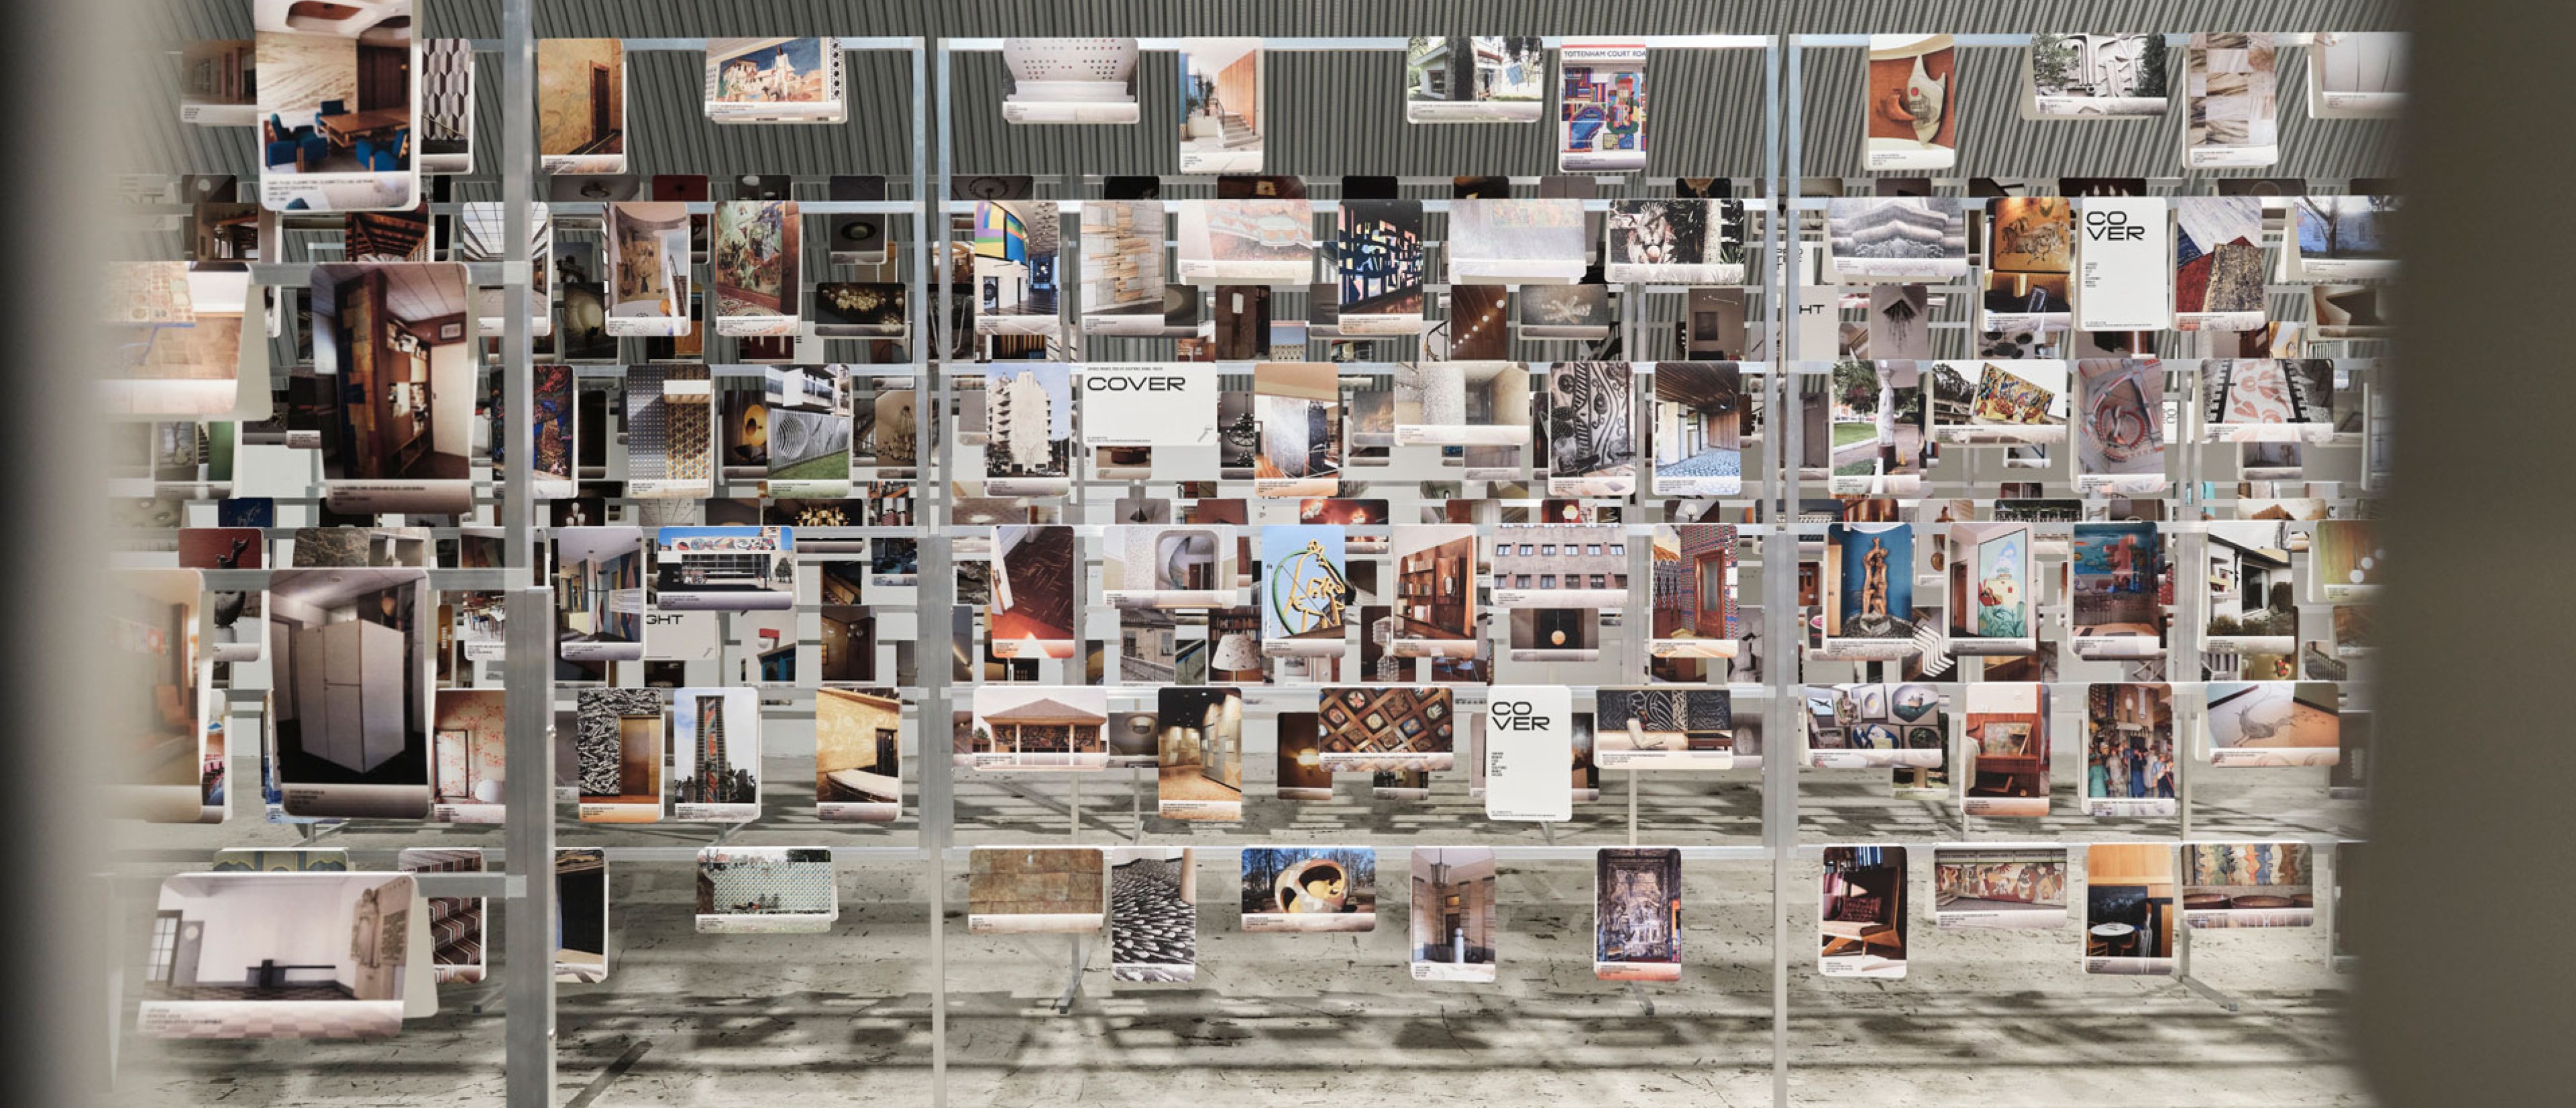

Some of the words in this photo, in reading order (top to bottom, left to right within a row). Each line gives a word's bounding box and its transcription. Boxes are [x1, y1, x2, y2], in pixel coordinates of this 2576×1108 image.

[2086, 211, 2127, 225] CO
[2086, 226, 2145, 241] VER
[1087, 376, 1185, 391] COVER
[1491, 701, 1532, 716] CO
[1491, 716, 1550, 731] VER
